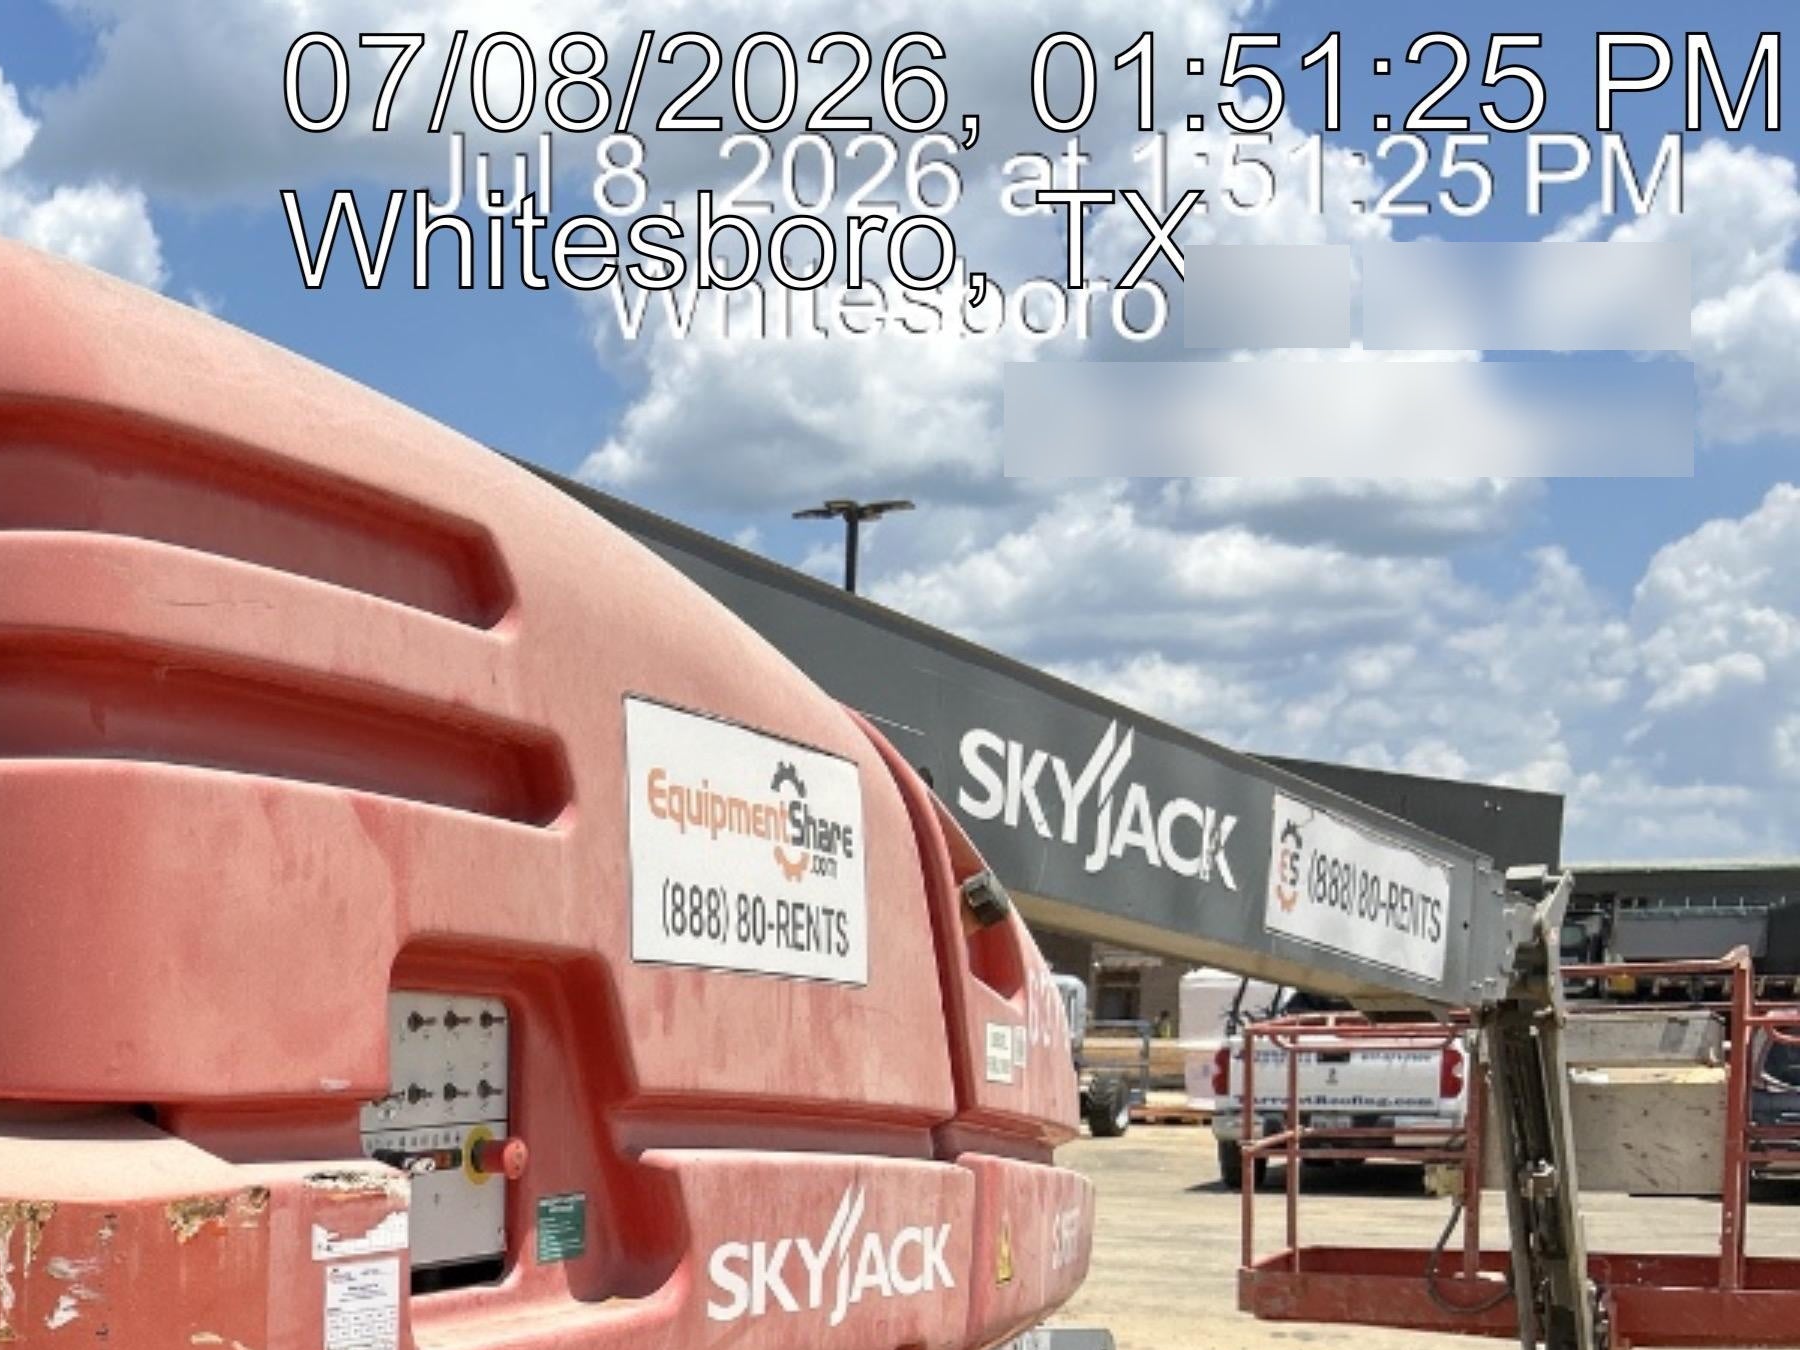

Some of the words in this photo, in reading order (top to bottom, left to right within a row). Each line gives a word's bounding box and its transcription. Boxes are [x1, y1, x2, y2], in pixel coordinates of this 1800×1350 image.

[647, 766, 854, 859] EquipmentShare
[958, 718, 1238, 892] SKYJACK
[661, 877, 729, 944] (888)
[736, 892, 850, 958] 80-RENTS
[1358, 868, 1442, 944] 80-RENTS
[706, 1181, 956, 1327] SKYJACK
